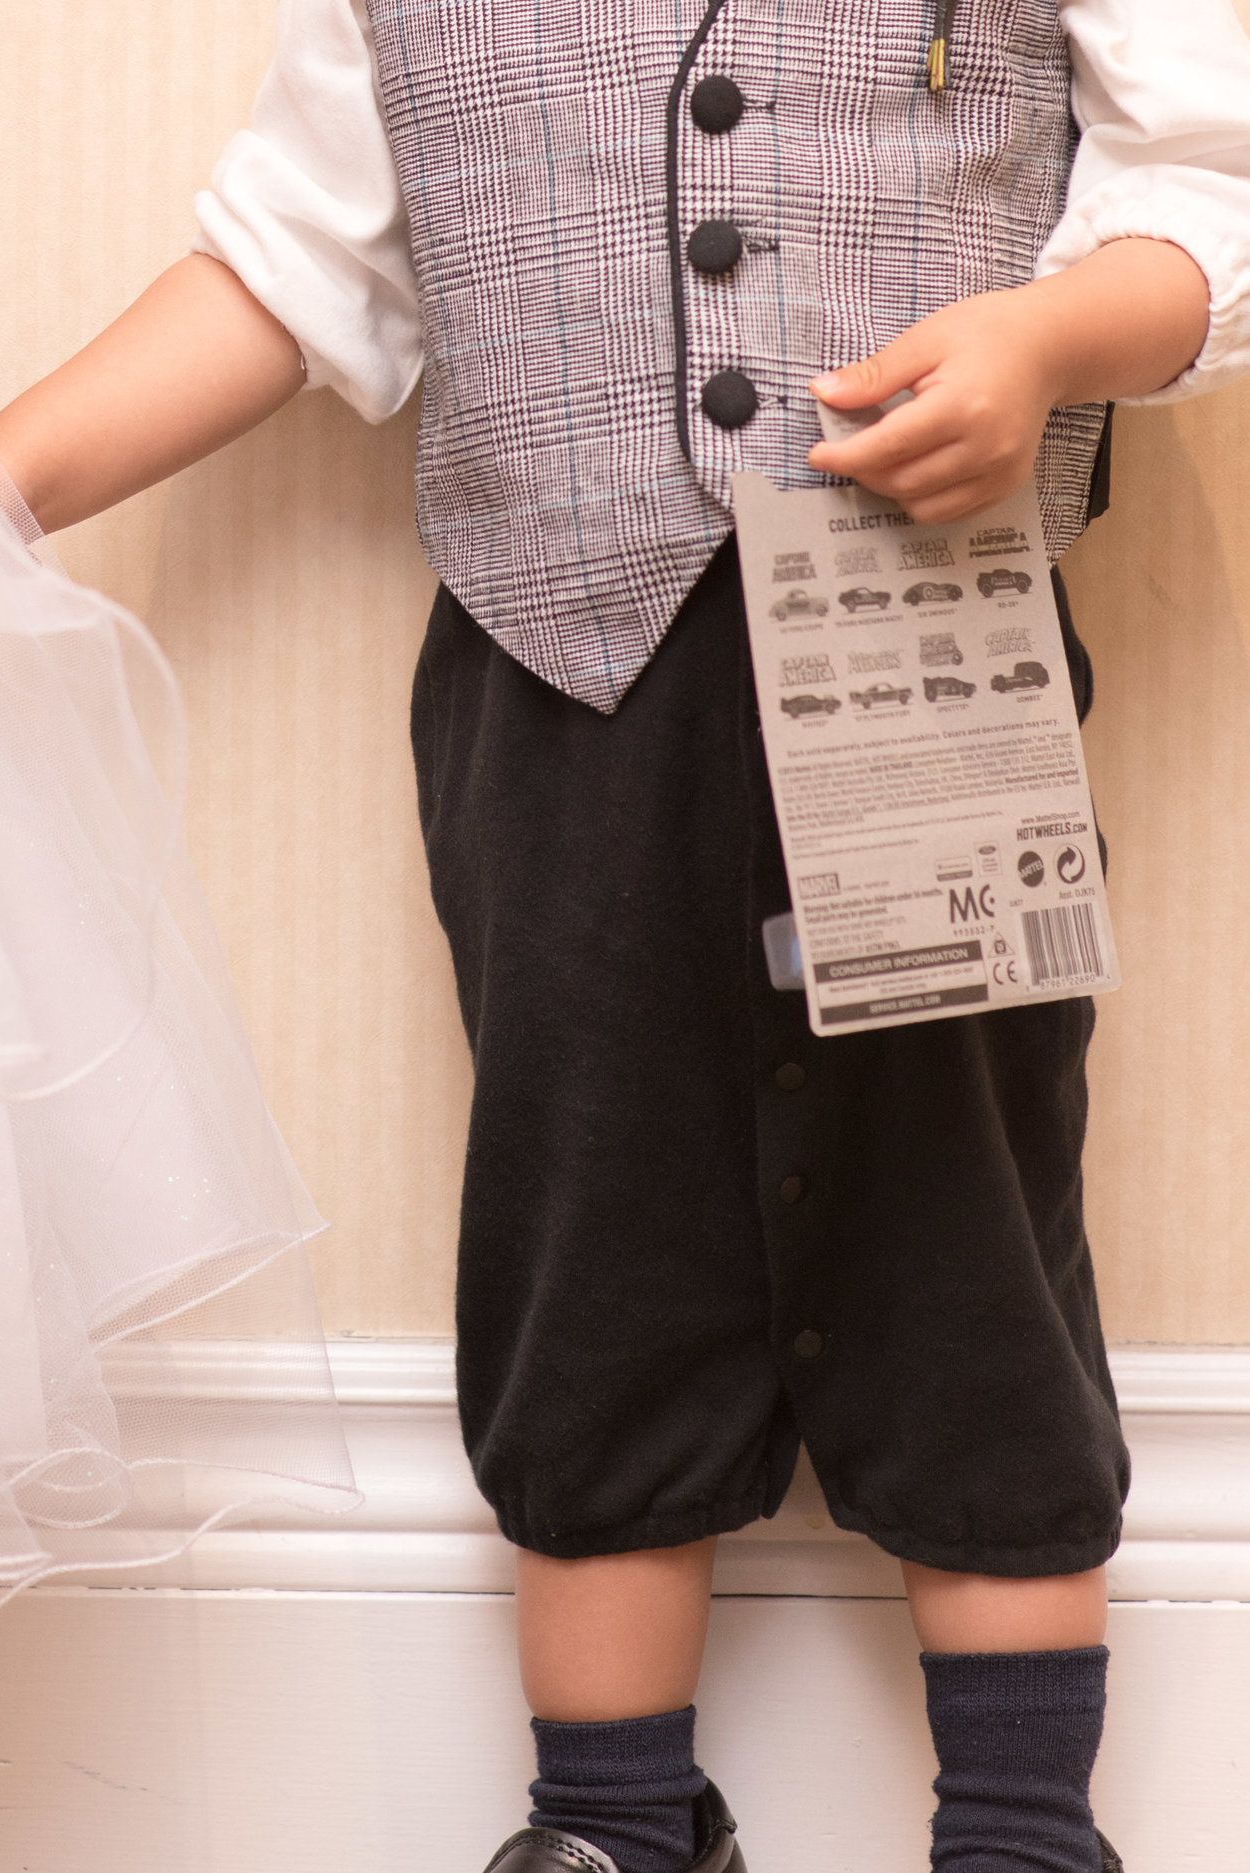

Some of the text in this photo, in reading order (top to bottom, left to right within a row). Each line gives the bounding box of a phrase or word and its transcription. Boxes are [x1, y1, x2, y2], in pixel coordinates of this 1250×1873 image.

[828, 510, 914, 532] COLLECT THE
[897, 548, 954, 570] AMERICA
[942, 728, 966, 739] Colors
[967, 727, 980, 735] and
[981, 721, 1023, 733] decorations
[1024, 720, 1039, 729] may
[1041, 717, 1060, 727] vary.
[828, 946, 968, 978] CONSUMER INFORMATION
